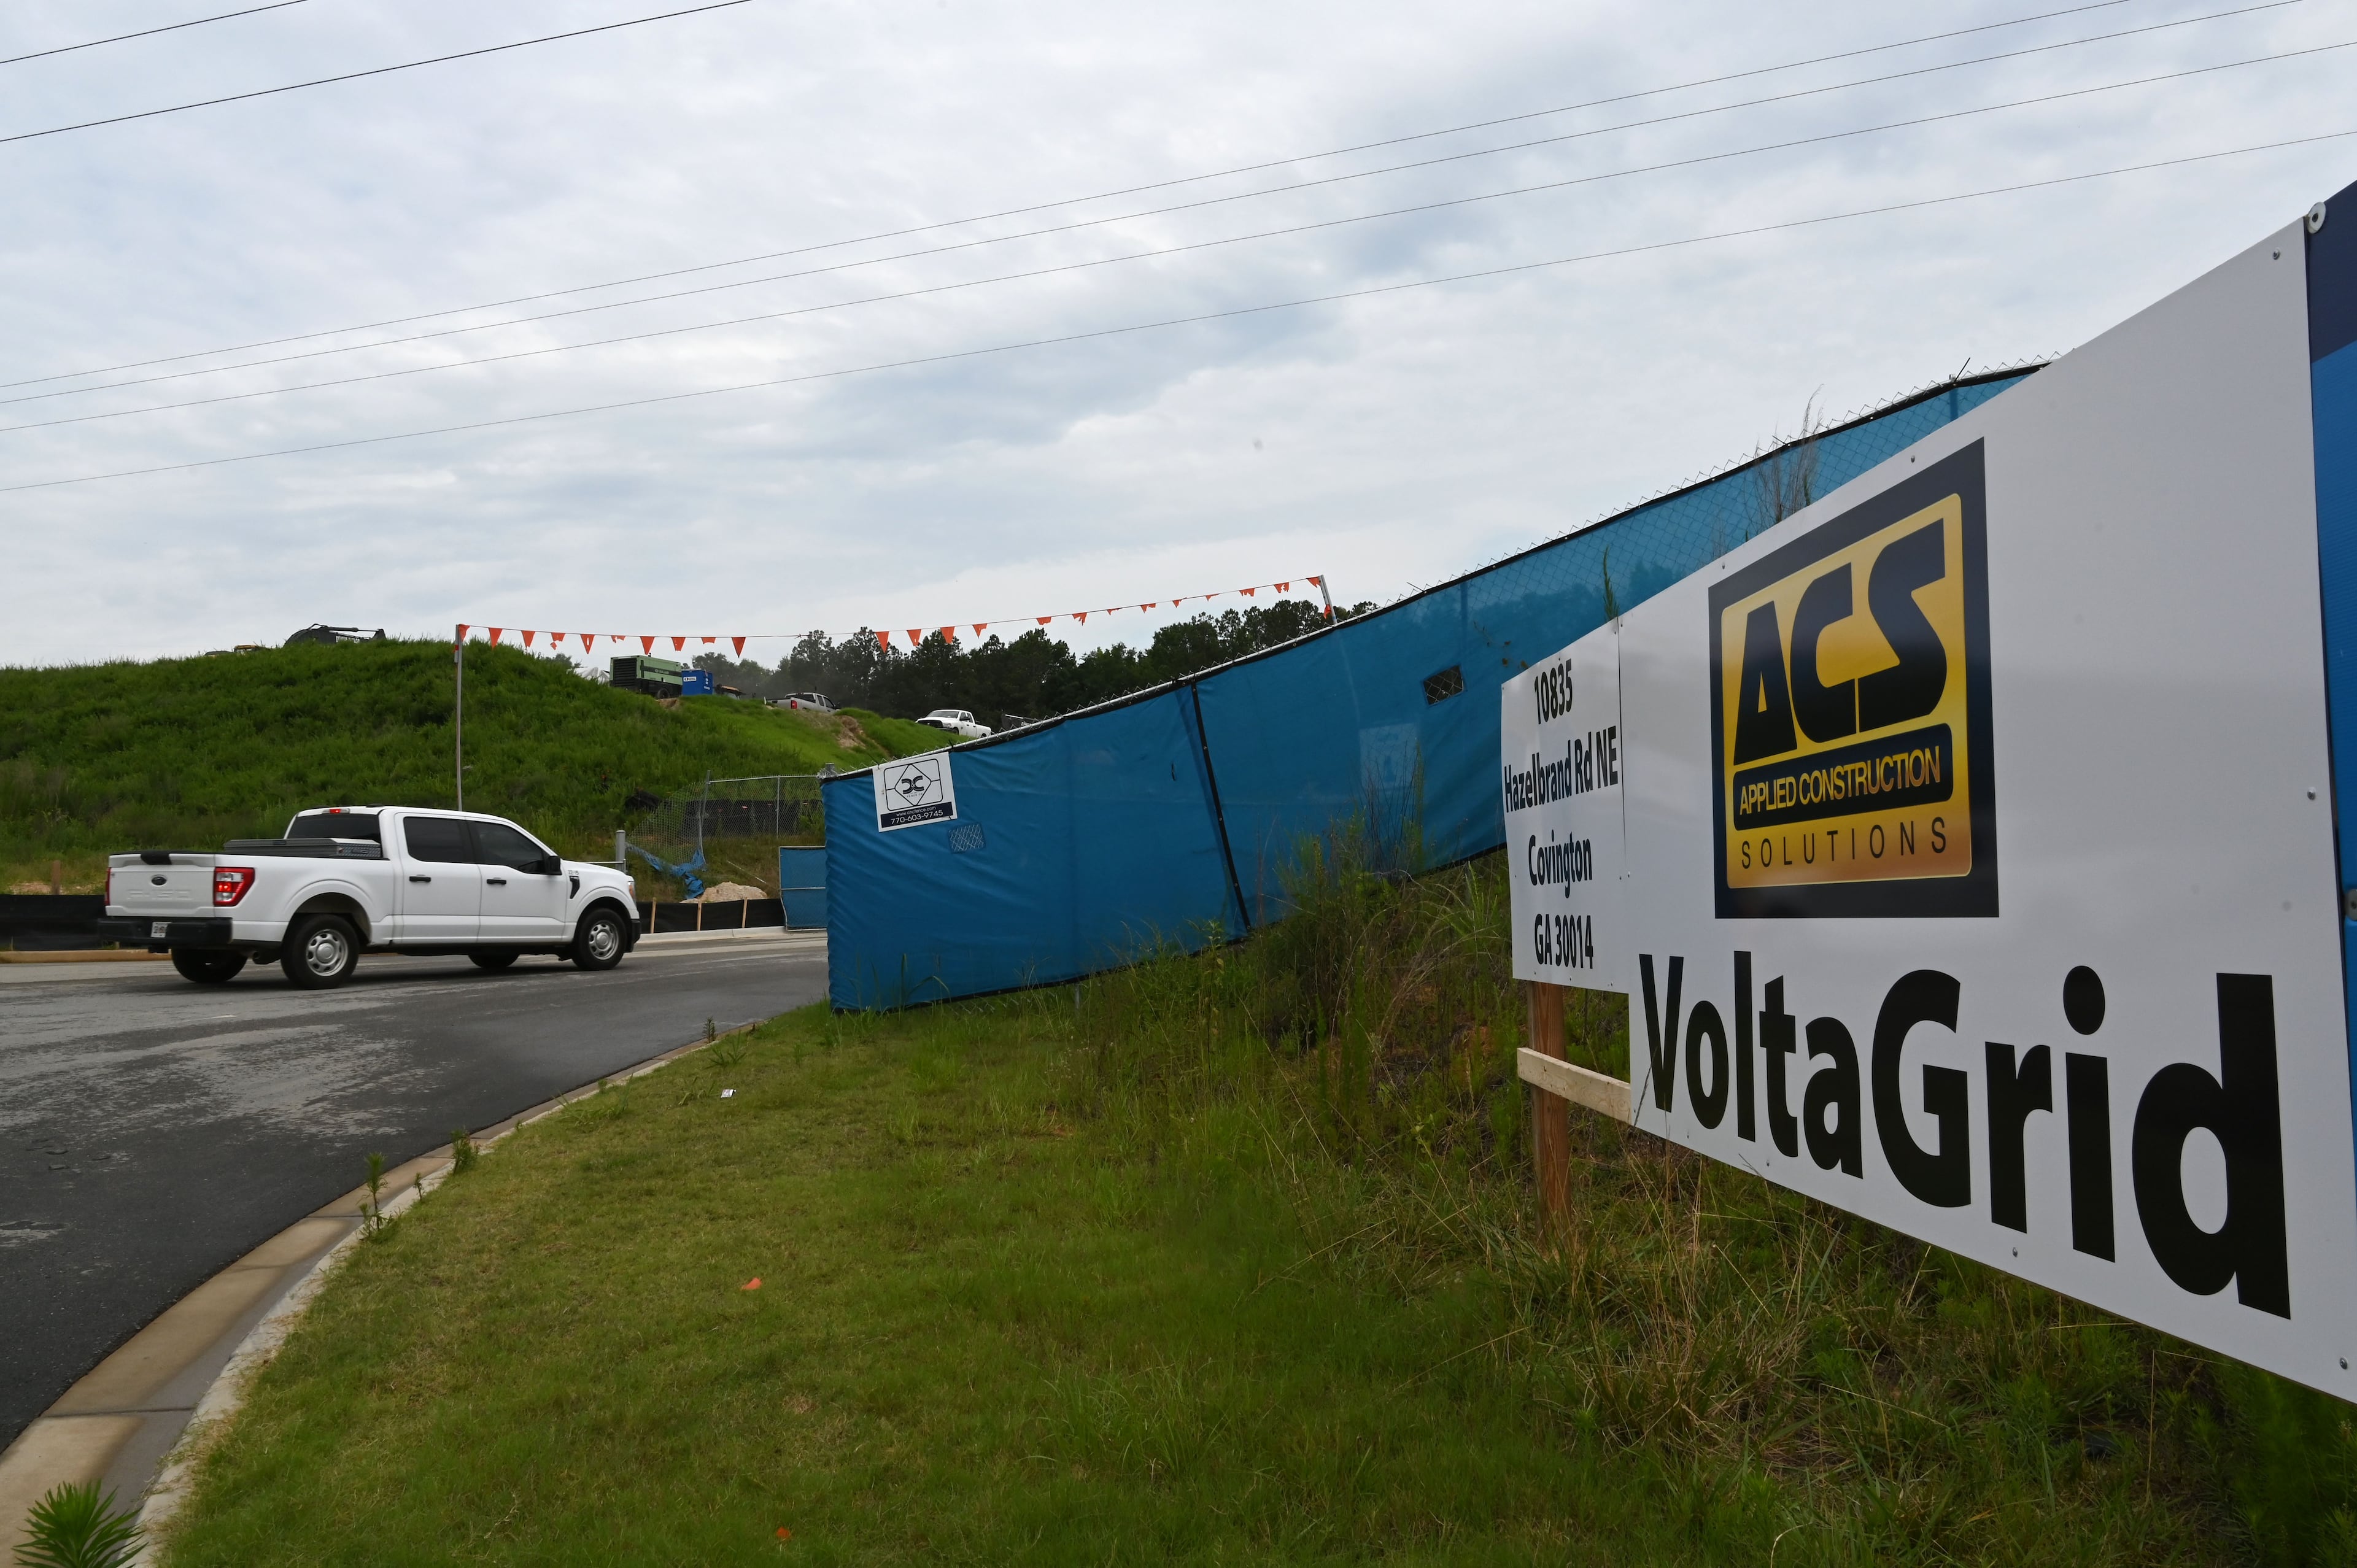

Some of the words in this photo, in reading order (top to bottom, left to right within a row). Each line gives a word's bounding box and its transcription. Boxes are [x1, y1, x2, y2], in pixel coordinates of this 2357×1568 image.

[1733, 518, 1947, 766] ACS
[1534, 658, 1573, 725] 10835
[1504, 740, 1571, 813] Hazelbrand
[1574, 732, 1593, 795] Rd
[1596, 725, 1619, 789] NE
[1740, 776, 1796, 816] APPLIED
[1799, 746, 1940, 805] CONSTRUCTION
[891, 810, 943, 824] 770-603-9745
[896, 806, 936, 816] www.cncfence.com
[1741, 816, 1946, 870] SOLUTIONS
[1528, 829, 1592, 898] Covington
[1535, 913, 1552, 965] GA
[1555, 914, 1593, 970] 30014
[1639, 951, 2291, 1319] VoltaGrid
